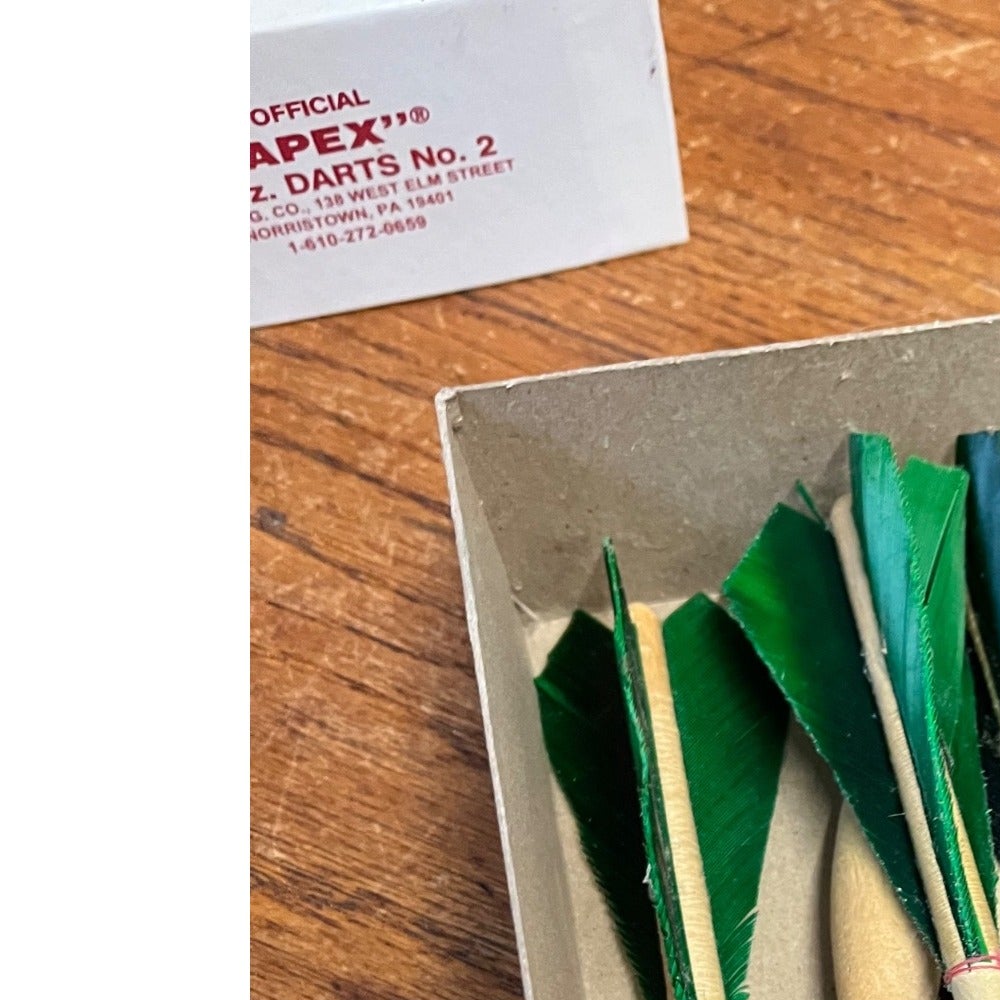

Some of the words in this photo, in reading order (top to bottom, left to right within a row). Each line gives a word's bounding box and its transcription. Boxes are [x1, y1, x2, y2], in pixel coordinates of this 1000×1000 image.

[250, 89, 370, 126] OFFICIAL
[284, 154, 401, 195] DARTS
[410, 146, 466, 170] No.
[476, 135, 497, 157] 2
[316, 193, 345, 210] 138
[348, 183, 398, 203] WEST
[404, 173, 442, 192] ELM
[447, 158, 515, 184] STREET
[377, 201, 402, 216] PA
[407, 191, 454, 209] 19401
